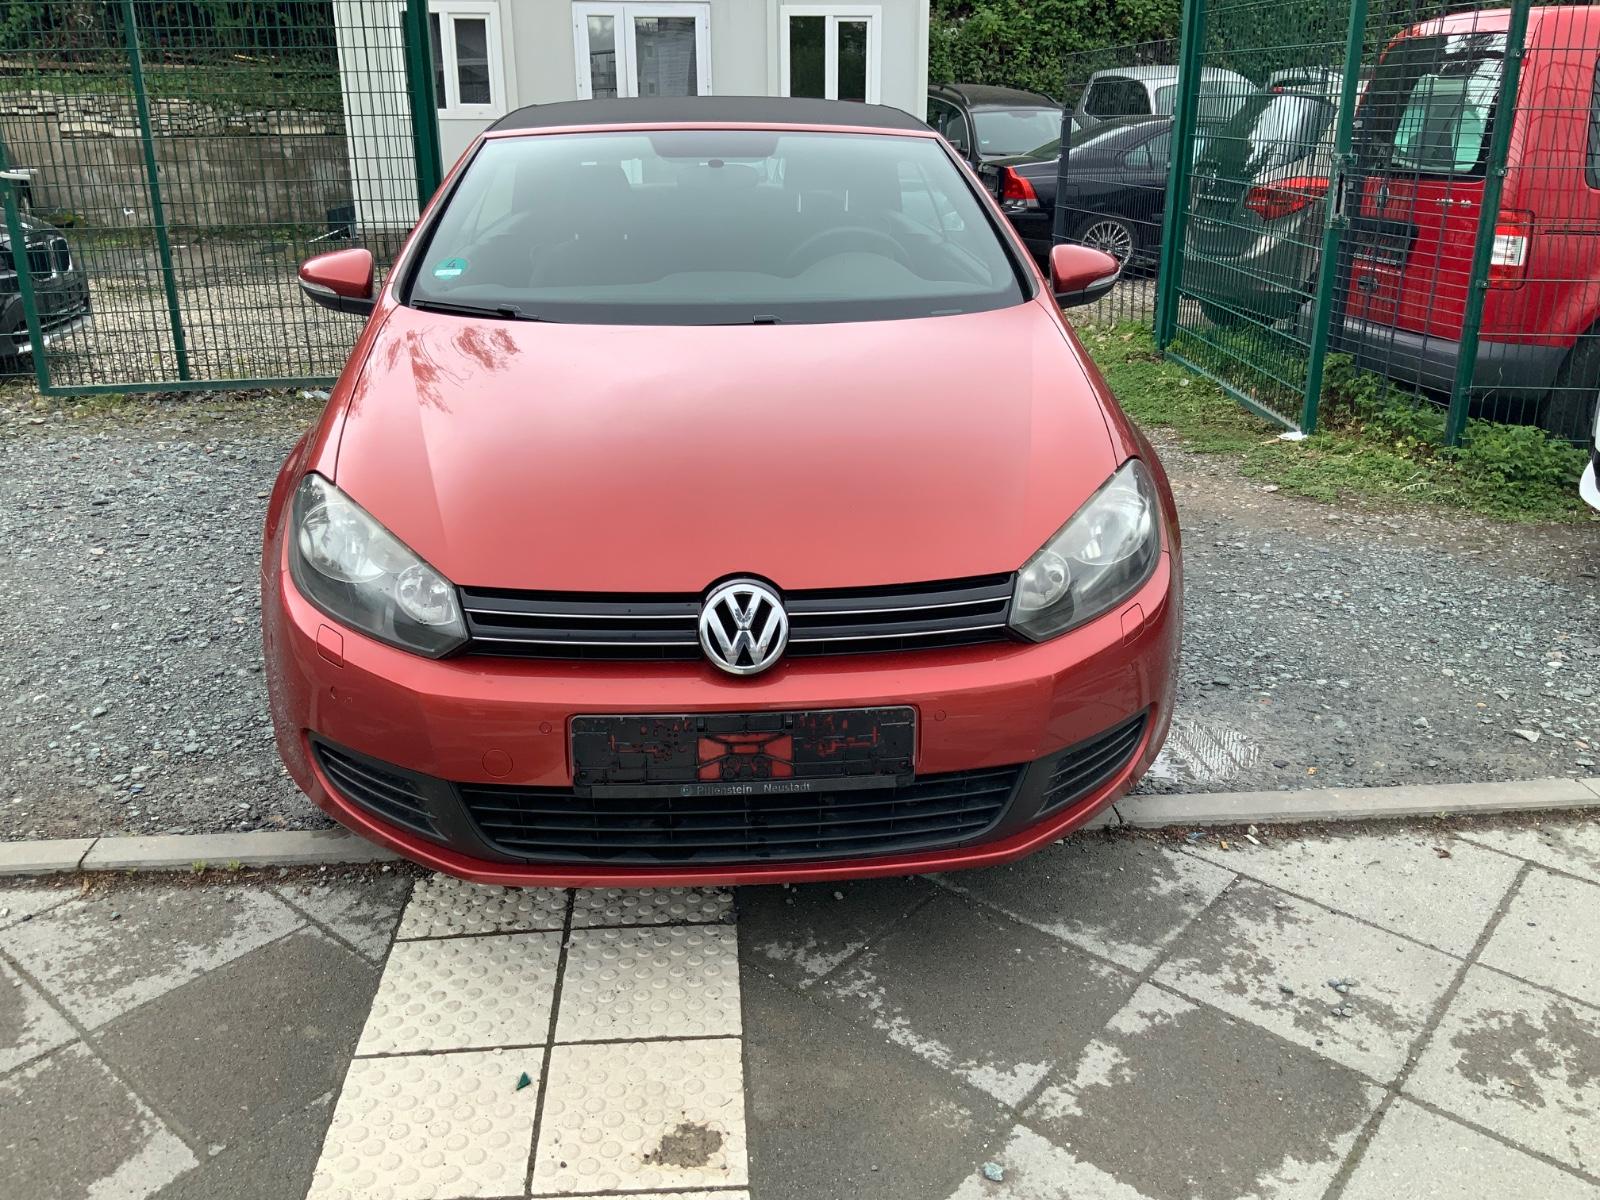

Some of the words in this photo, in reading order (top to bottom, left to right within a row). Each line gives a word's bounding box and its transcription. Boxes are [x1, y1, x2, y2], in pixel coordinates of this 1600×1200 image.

[447, 259, 457, 270] 4
[703, 585, 785, 669] VW
[763, 782, 811, 793] Neustadt
